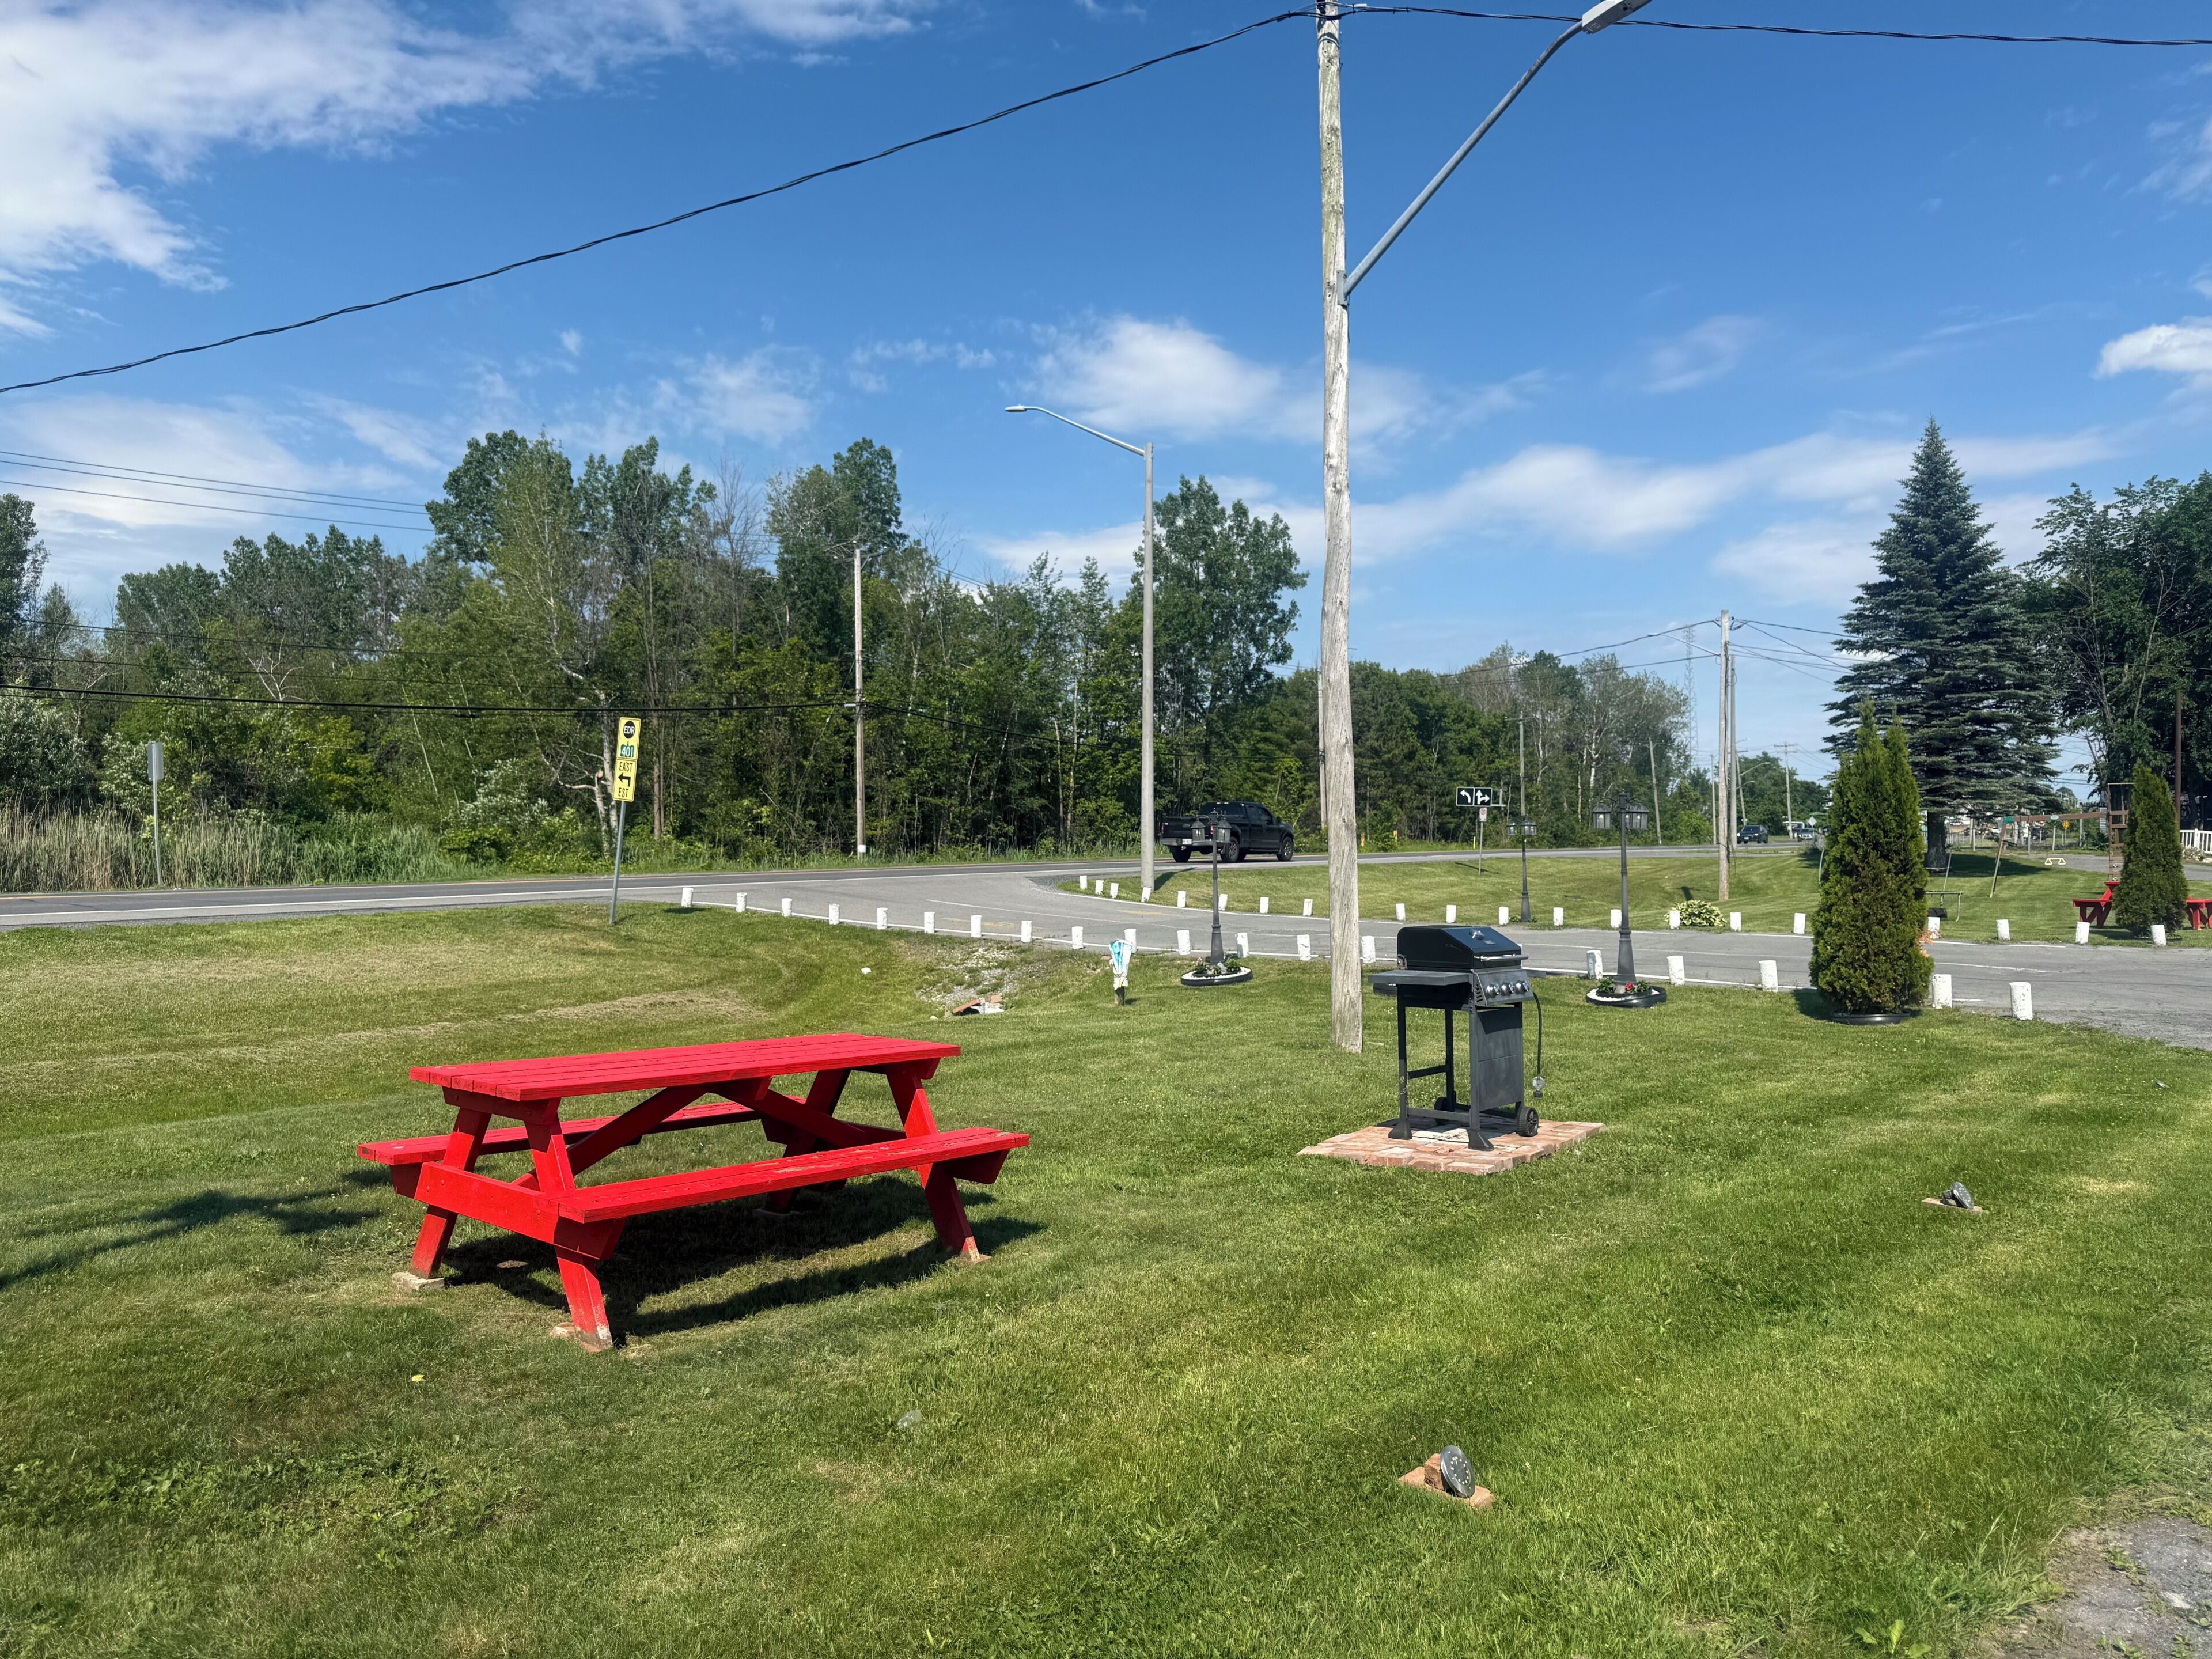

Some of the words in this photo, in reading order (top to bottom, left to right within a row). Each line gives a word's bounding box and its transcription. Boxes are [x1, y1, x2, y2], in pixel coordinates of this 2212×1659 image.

[624, 726, 635, 734] EDR
[622, 746, 634, 757] 401
[619, 762, 633, 772] EAST
[618, 787, 629, 798] EST
